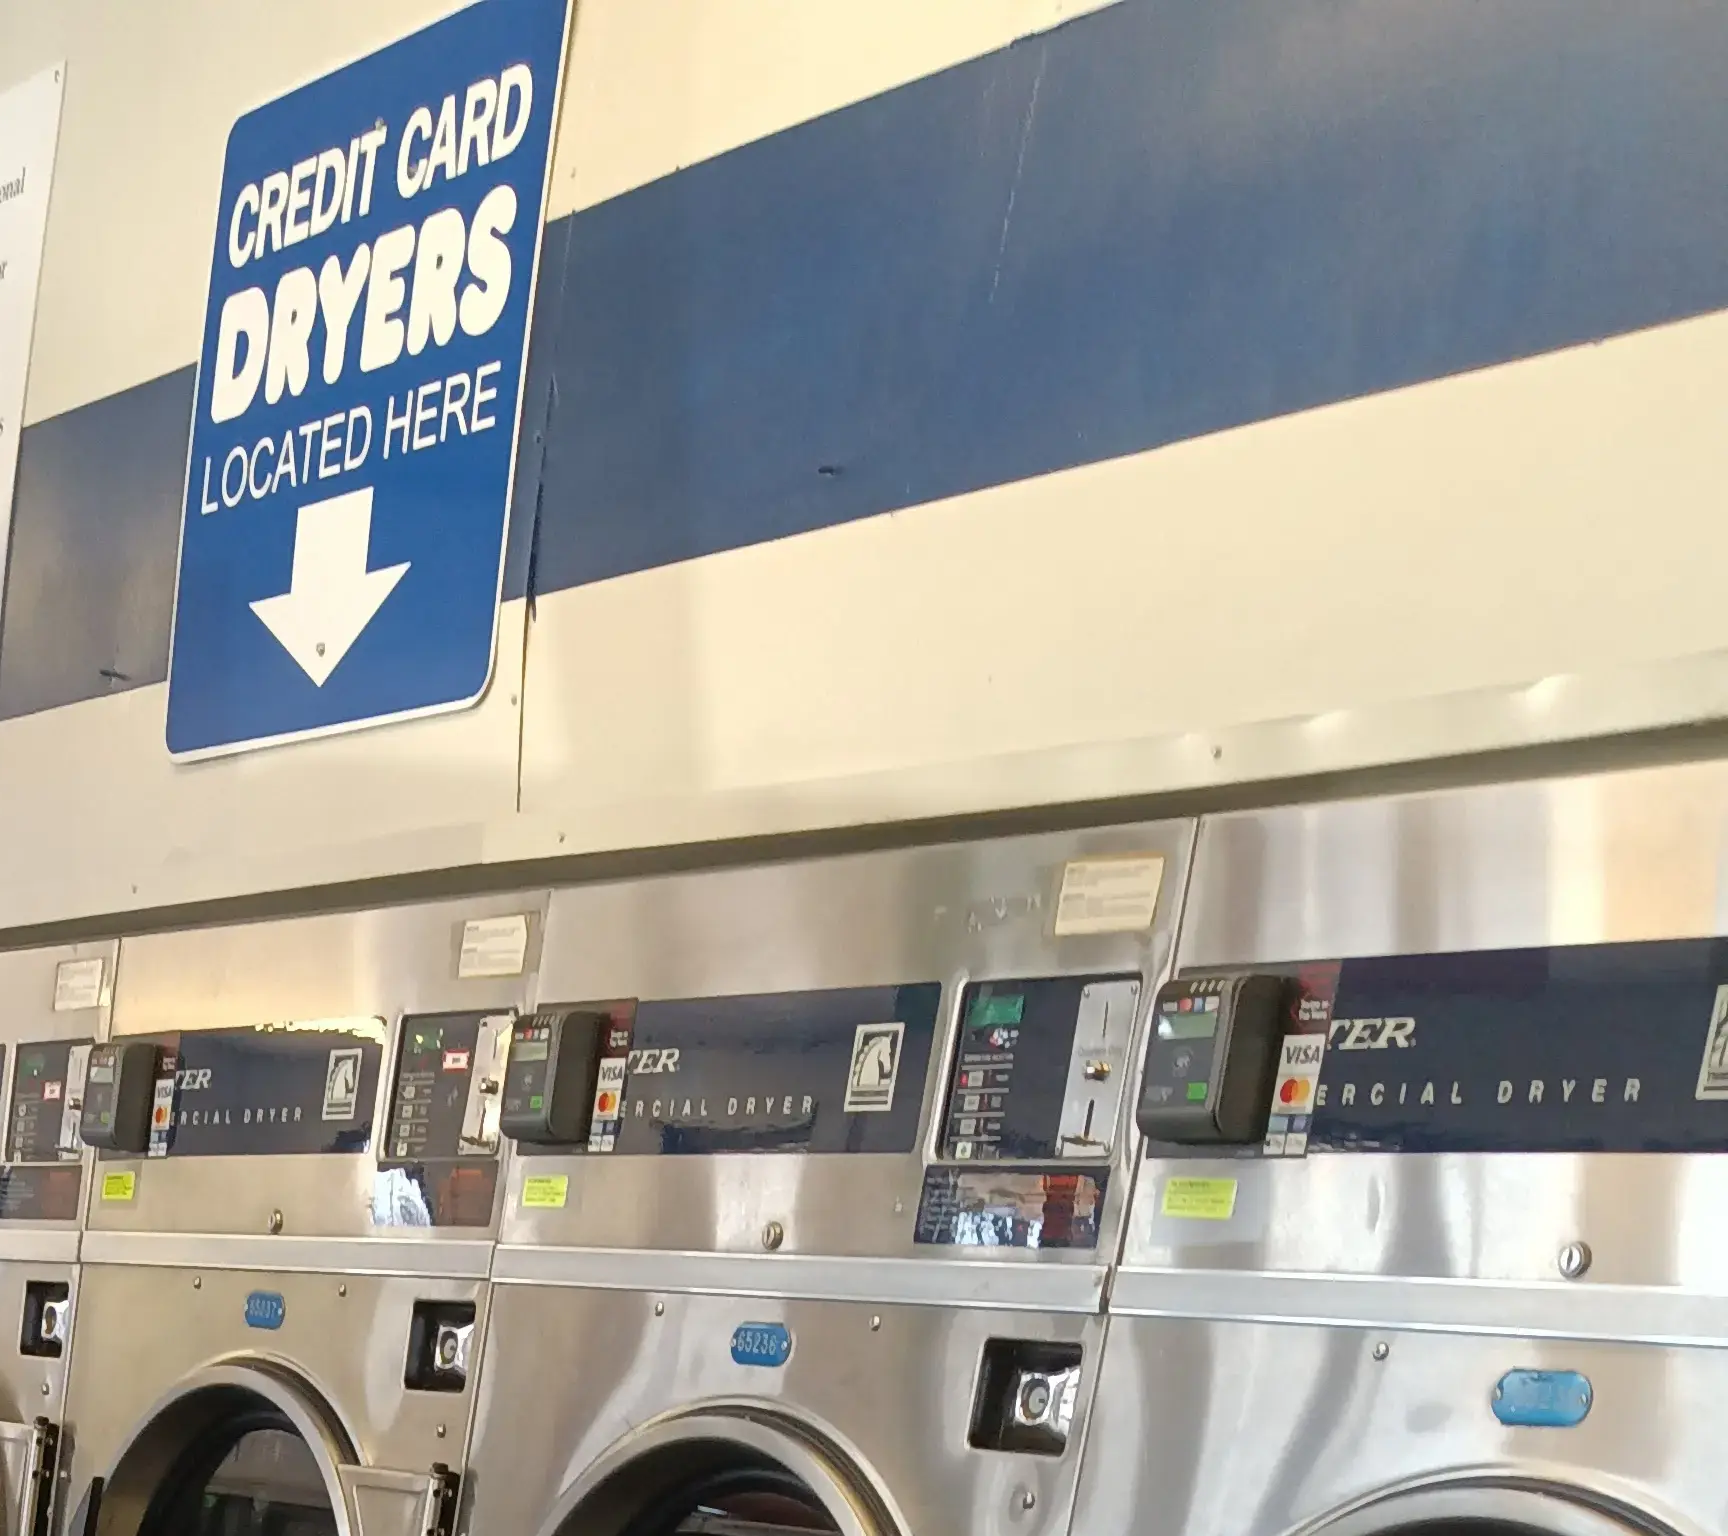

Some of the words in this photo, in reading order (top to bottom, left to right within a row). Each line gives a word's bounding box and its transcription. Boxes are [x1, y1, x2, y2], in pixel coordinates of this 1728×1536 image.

[228, 126, 387, 269] CREDIT
[396, 63, 533, 198] CARD
[210, 184, 518, 424] DRYERS
[201, 404, 372, 515] LOCATED
[383, 360, 502, 459] HERE
[1285, 1046, 1320, 1065] VISA
[602, 1066, 623, 1082] VISA
[1496, 1077, 1642, 1104] DRYER
[243, 1106, 302, 1124] DRYER
[727, 1095, 813, 1116] DRYER
